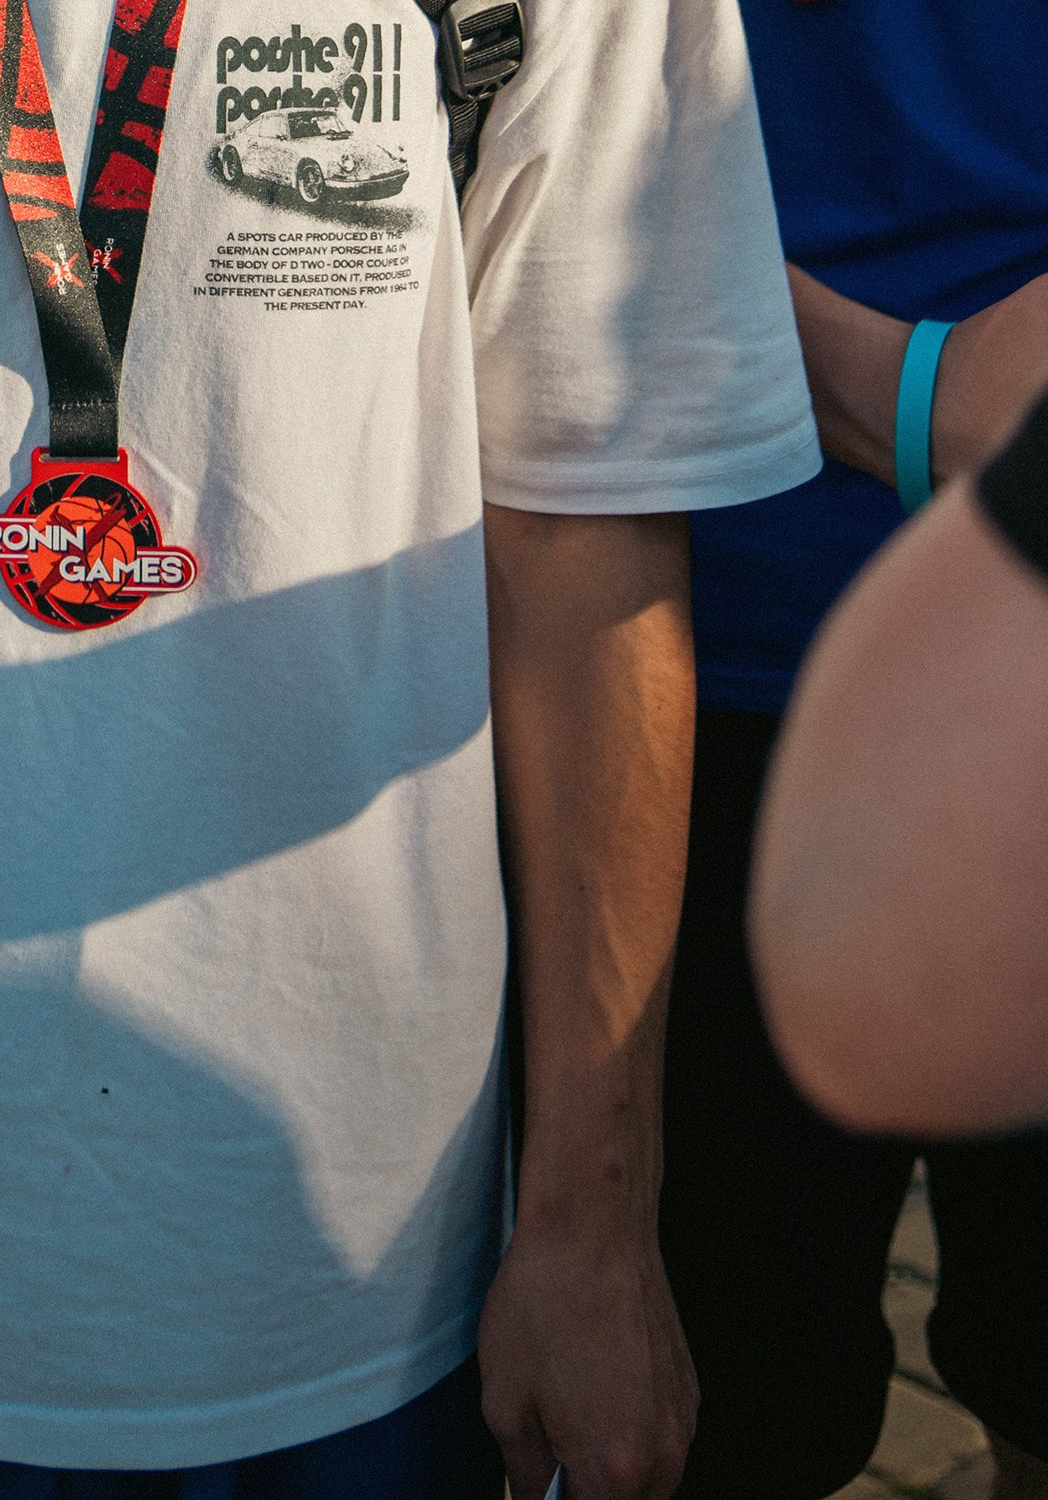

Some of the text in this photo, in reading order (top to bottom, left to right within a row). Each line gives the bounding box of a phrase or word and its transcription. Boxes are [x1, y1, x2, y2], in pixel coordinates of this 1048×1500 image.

[343, 22, 402, 73] 911
[343, 73, 401, 124] 911
[227, 232, 235, 241] A
[238, 233, 277, 242] SPOTS
[279, 233, 303, 242] CAR
[305, 232, 368, 242] PRODUCED
[370, 232, 384, 241] BY
[217, 246, 269, 256] GERMAN
[272, 246, 328, 256] COMPANY
[330, 245, 384, 255] PORSCHE
[385, 244, 398, 254] AG
[210, 259, 234, 269] THE
[237, 260, 269, 270] BODY
[271, 261, 287, 270] OF
[301, 260, 325, 269] TWO
[333, 259, 364, 269] DOOR
[366, 257, 400, 268] COUPE
[205, 272, 289, 283] CONVERTIBLE
[291, 273, 329, 284] BASED
[330, 273, 347, 283] ON
[193, 286, 207, 296] IN
[208, 287, 276, 297] DIFFERENT
[277, 286, 357, 298] GENERATIONS
[359, 285, 388, 296] FROM
[408, 280, 420, 290] TO
[264, 301, 288, 311] THE
[290, 300, 341, 311] PRESENT
[59, 556, 184, 585] GAMES
